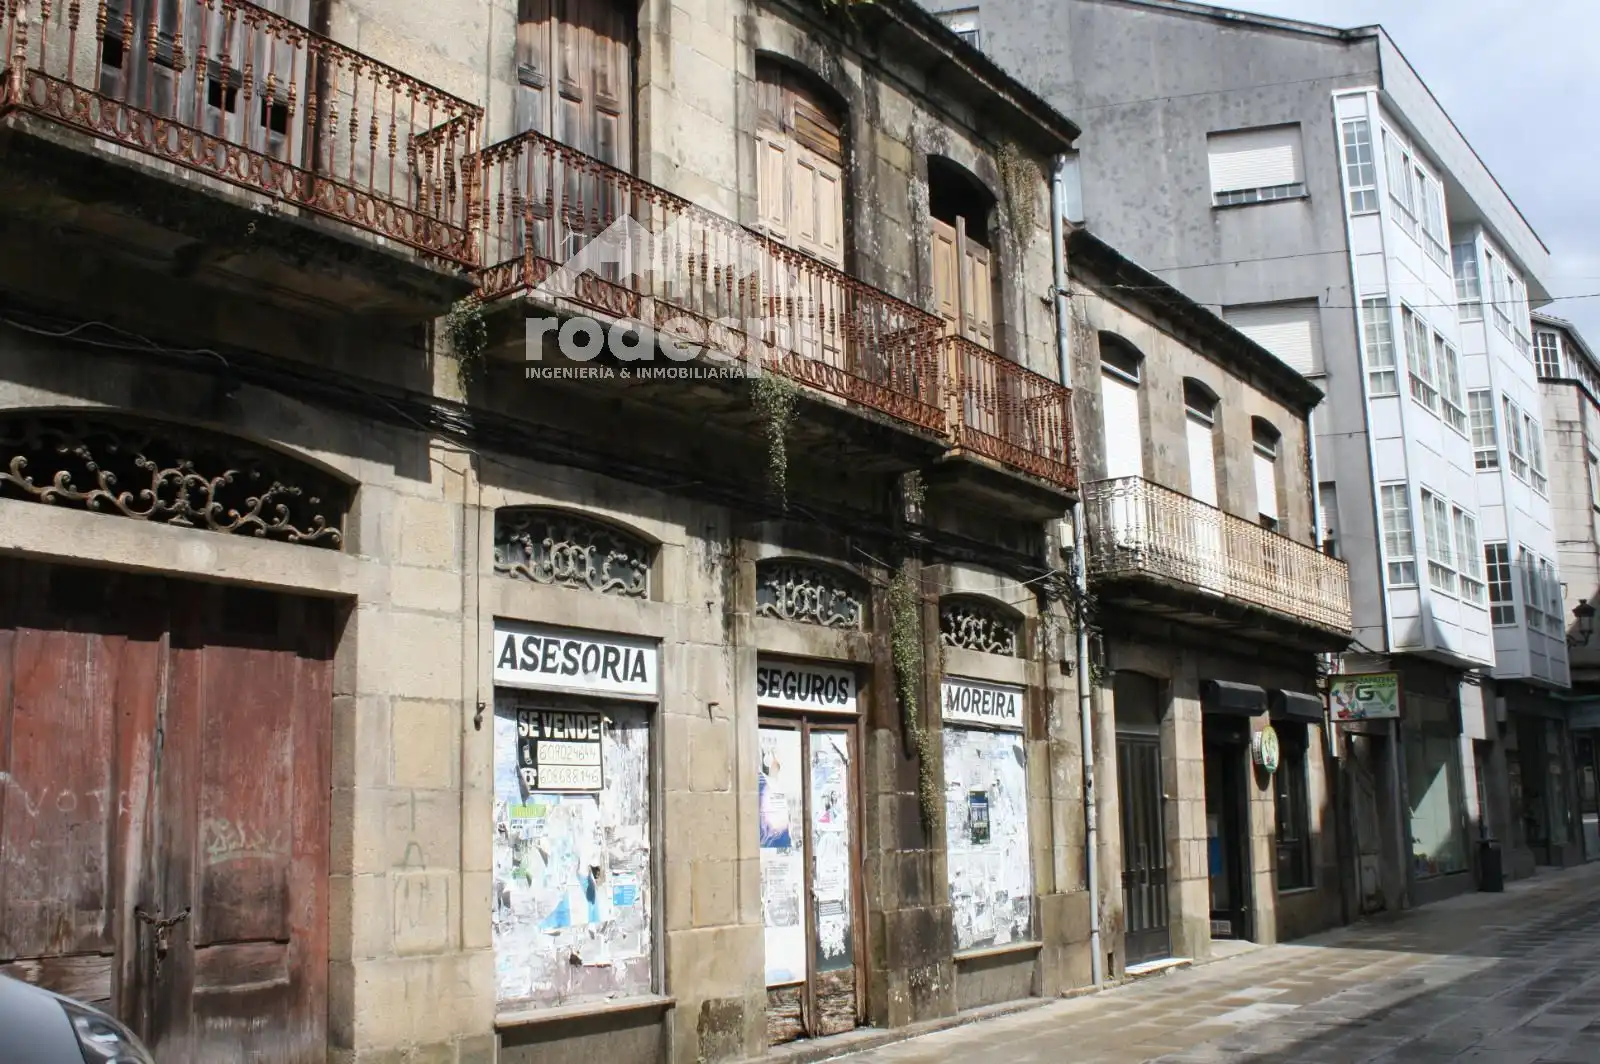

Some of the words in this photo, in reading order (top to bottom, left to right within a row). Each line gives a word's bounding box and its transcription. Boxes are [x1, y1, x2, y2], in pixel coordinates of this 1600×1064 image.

[498, 634, 647, 683] ASESORIA
[757, 667, 849, 705] SEGUROS
[946, 685, 1016, 717] MOREIRA
[518, 711, 540, 738] SE
[542, 712, 600, 740] VENDE
